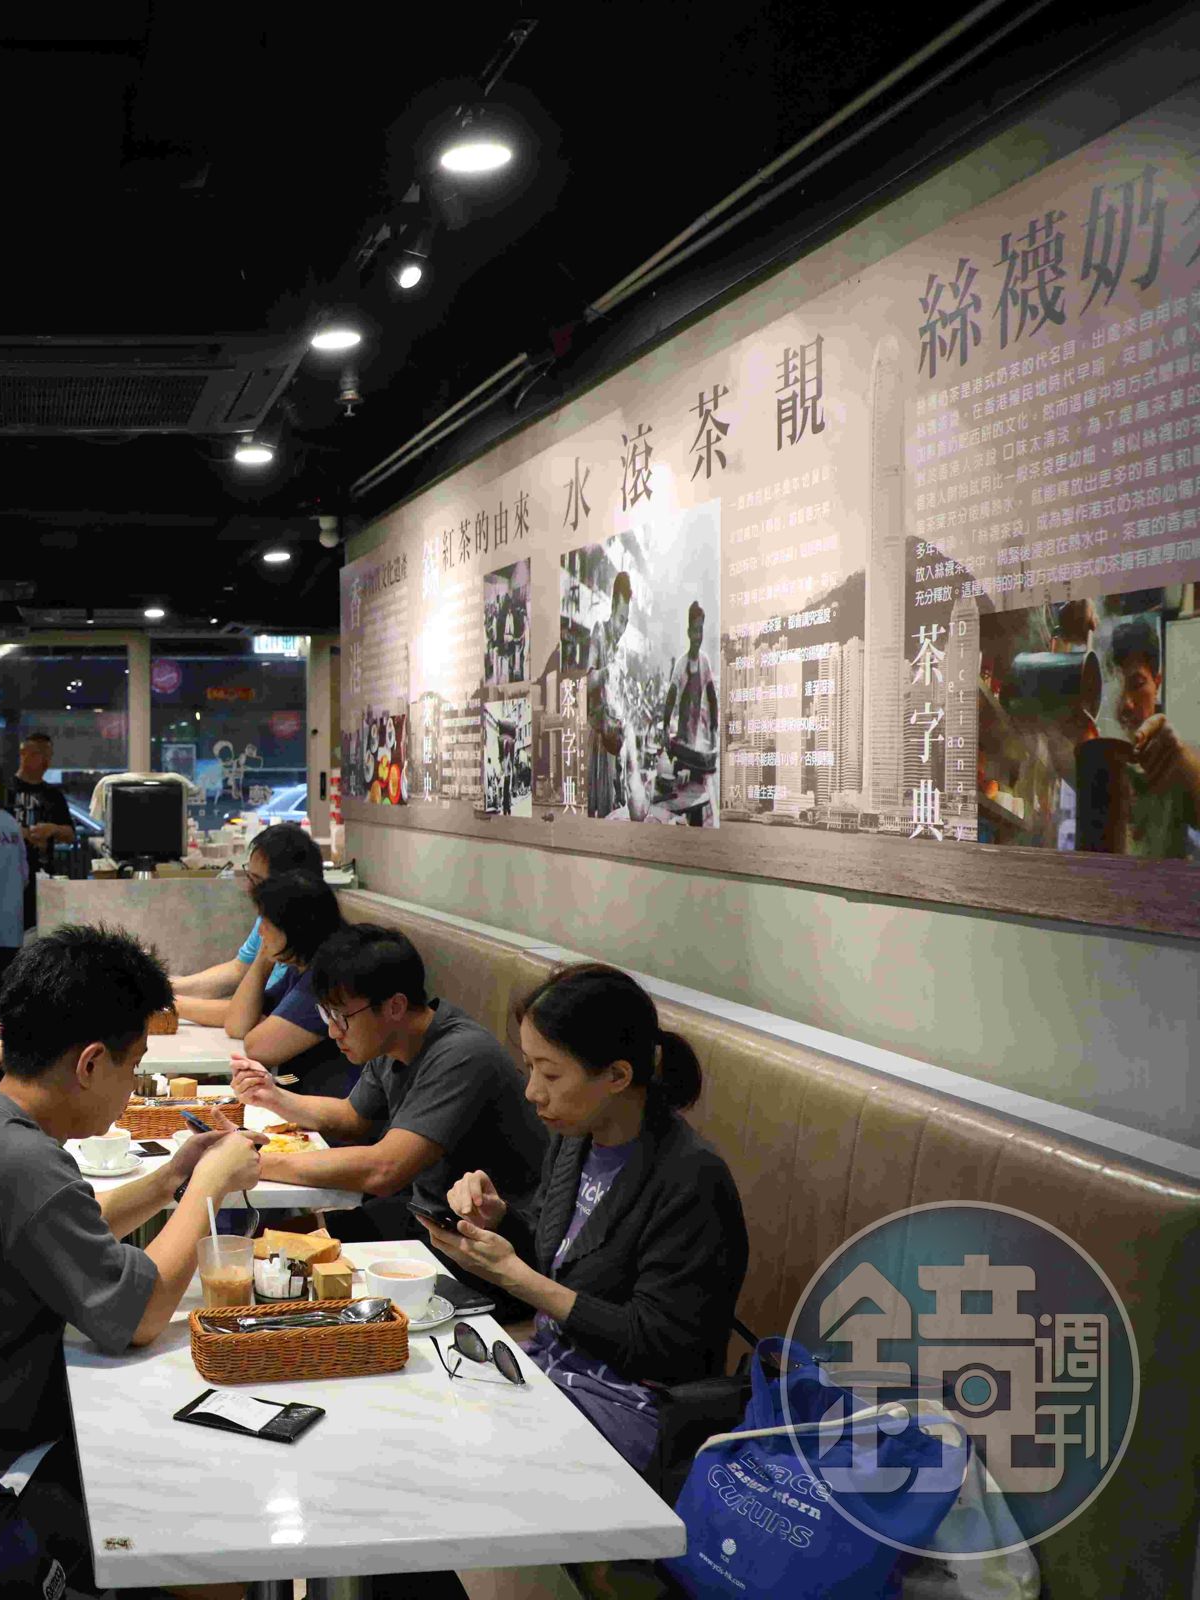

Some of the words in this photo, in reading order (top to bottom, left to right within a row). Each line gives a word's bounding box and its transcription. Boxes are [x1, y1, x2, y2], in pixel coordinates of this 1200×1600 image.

[918, 163, 1200, 379] 絲襪奶
[442, 490, 529, 573] 紅茶的由來
[562, 333, 826, 532] 水滾茶靚
[910, 623, 946, 842] 茶字典
